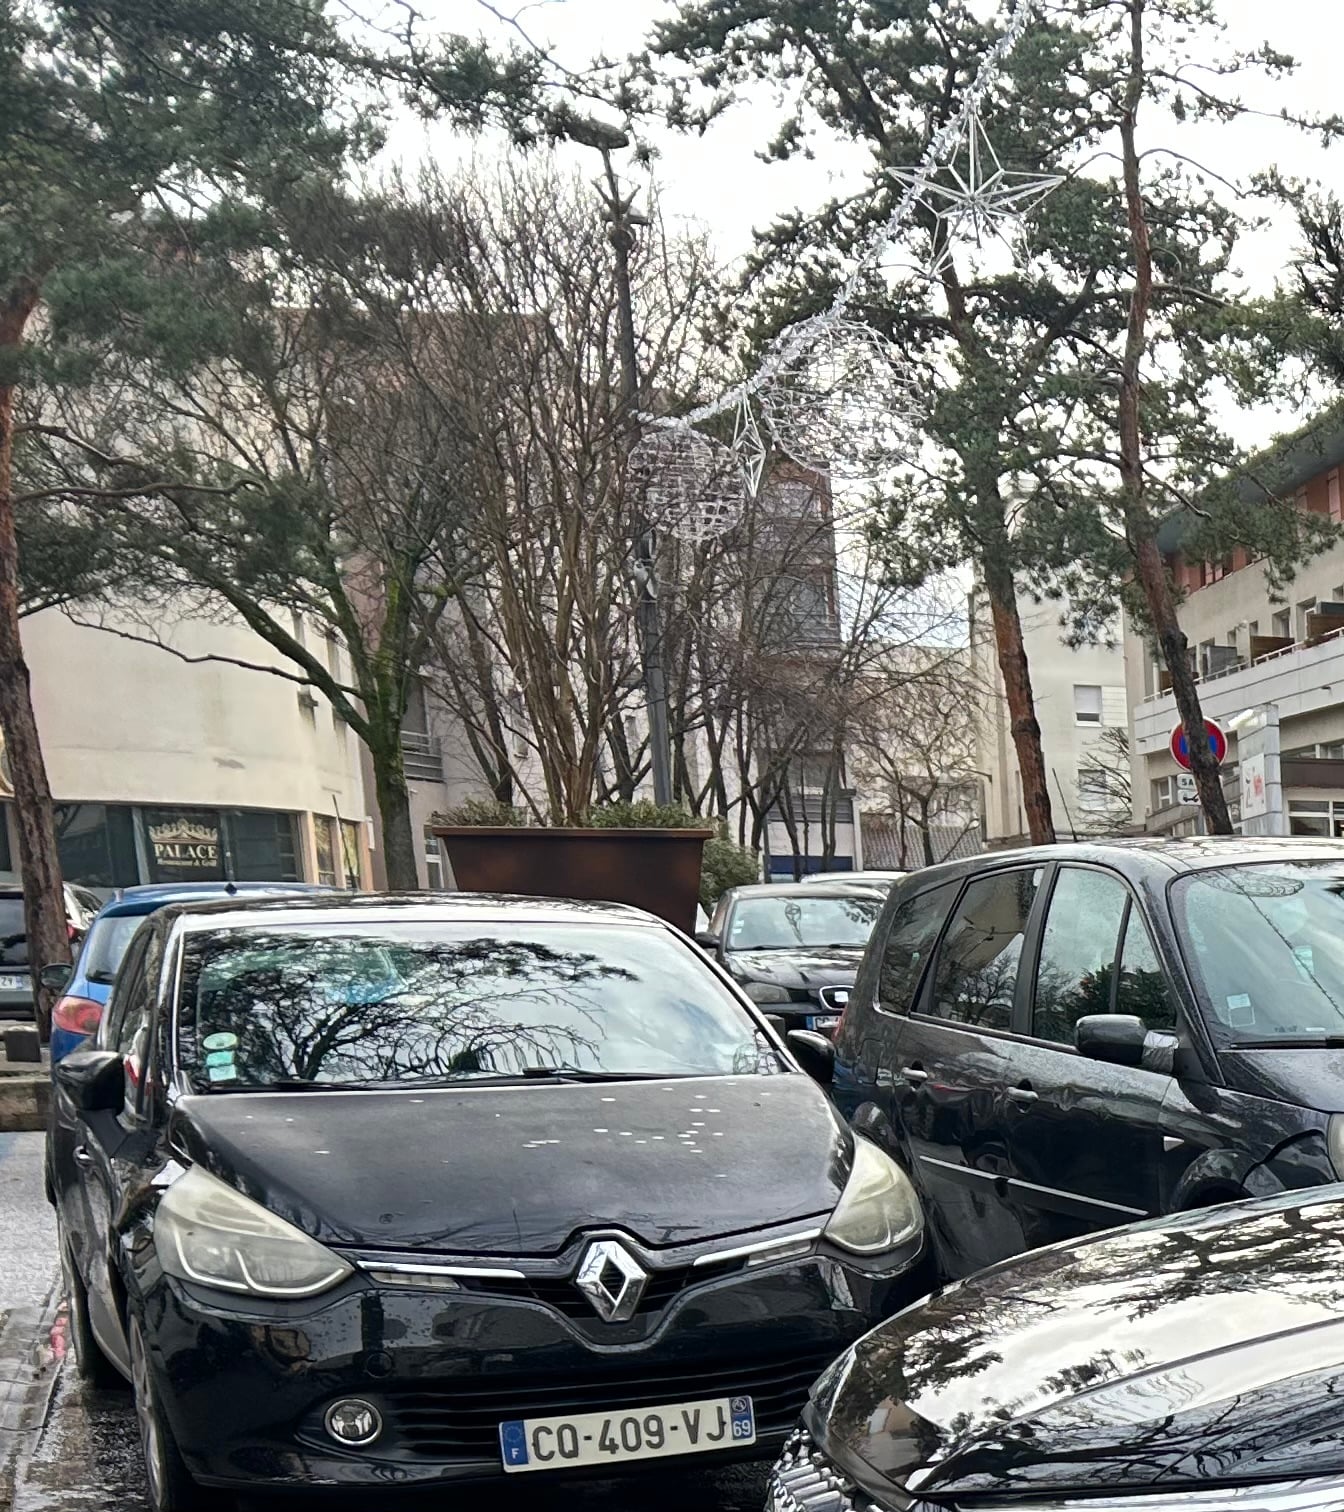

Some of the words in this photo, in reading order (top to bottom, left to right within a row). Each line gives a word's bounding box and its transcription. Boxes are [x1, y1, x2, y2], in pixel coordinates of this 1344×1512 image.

[154, 844, 218, 859] PALACE
[532, 1405, 727, 1462] CQ-409-VJ
[733, 1419, 752, 1437] 69
[511, 1447, 520, 1459] F
